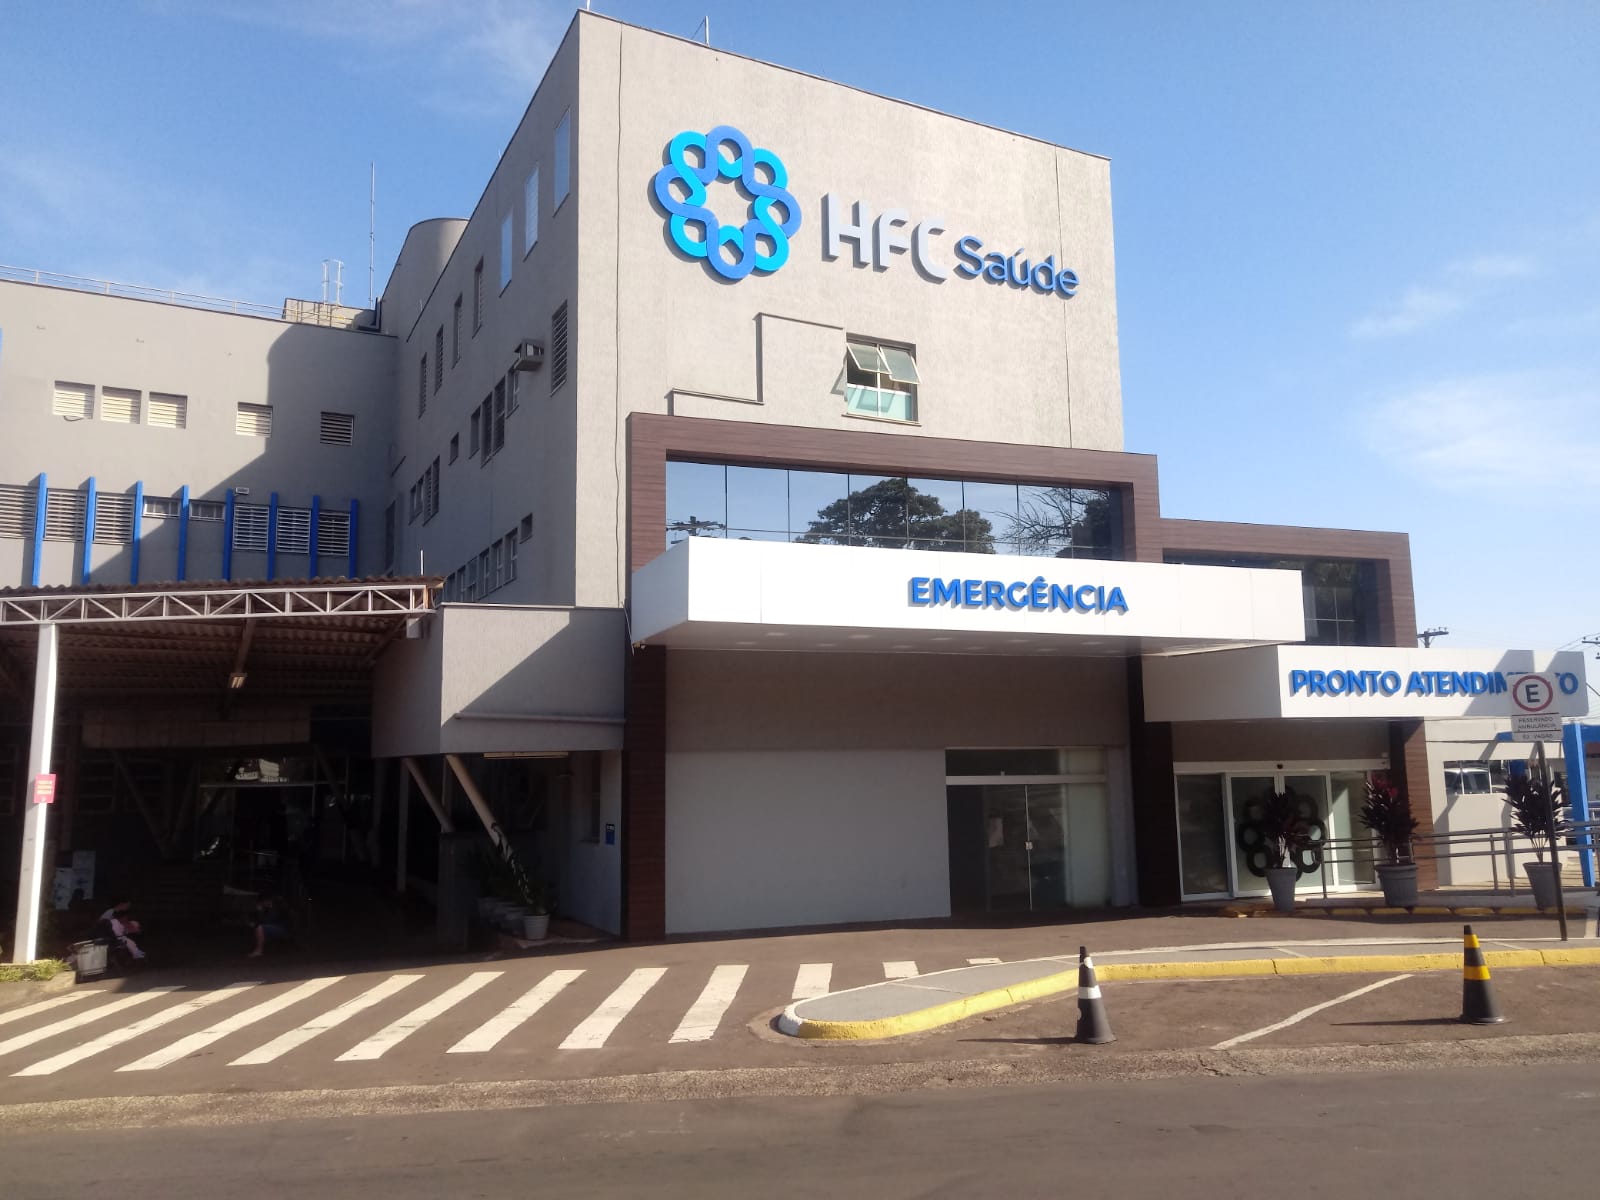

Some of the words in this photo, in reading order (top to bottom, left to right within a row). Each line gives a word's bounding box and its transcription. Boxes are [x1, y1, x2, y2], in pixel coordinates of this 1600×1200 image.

[822, 192, 948, 282] HFC
[956, 235, 1080, 298] Saúde
[909, 576, 1129, 612] EMERGÊNCIA
[1291, 669, 1401, 695] PRONTO
[1525, 684, 1540, 703] E
